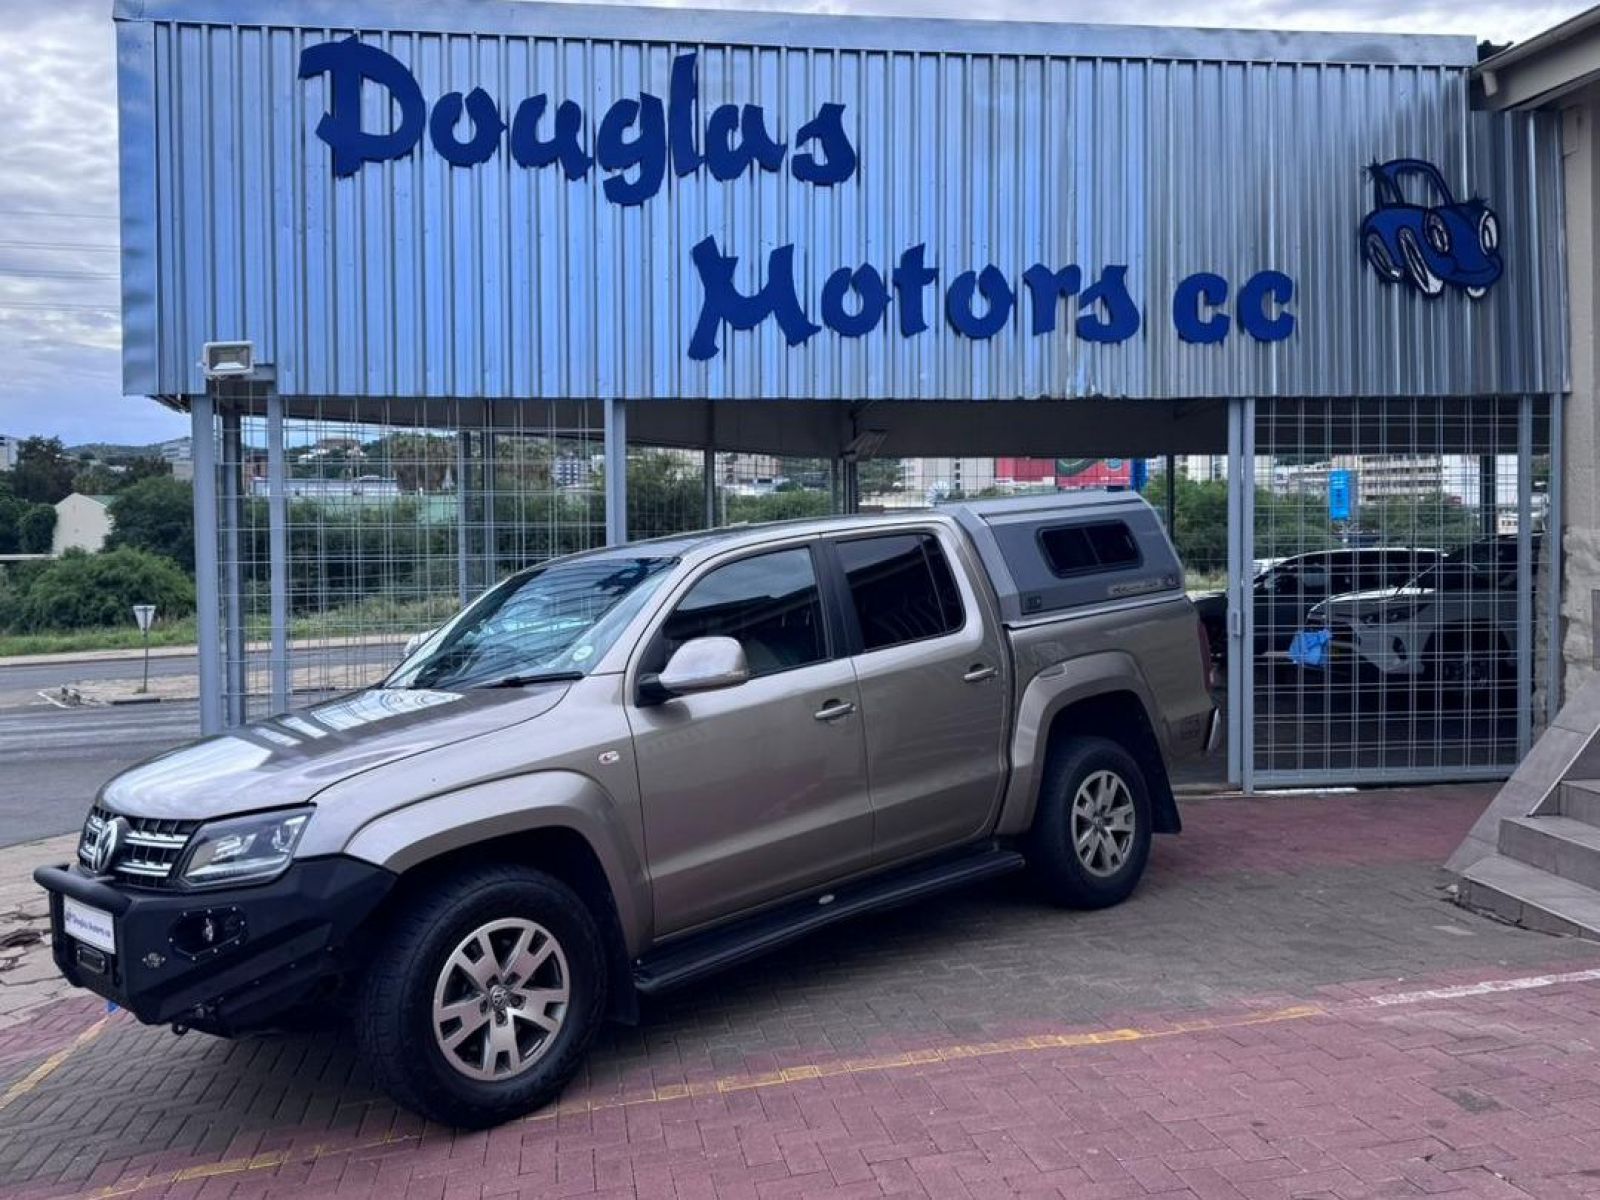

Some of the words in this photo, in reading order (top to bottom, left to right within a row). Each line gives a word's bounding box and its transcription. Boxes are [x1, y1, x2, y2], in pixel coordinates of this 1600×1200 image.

[298, 34, 857, 206] Douglas
[688, 235, 1139, 360] Motors
[1173, 270, 1294, 344] cc
